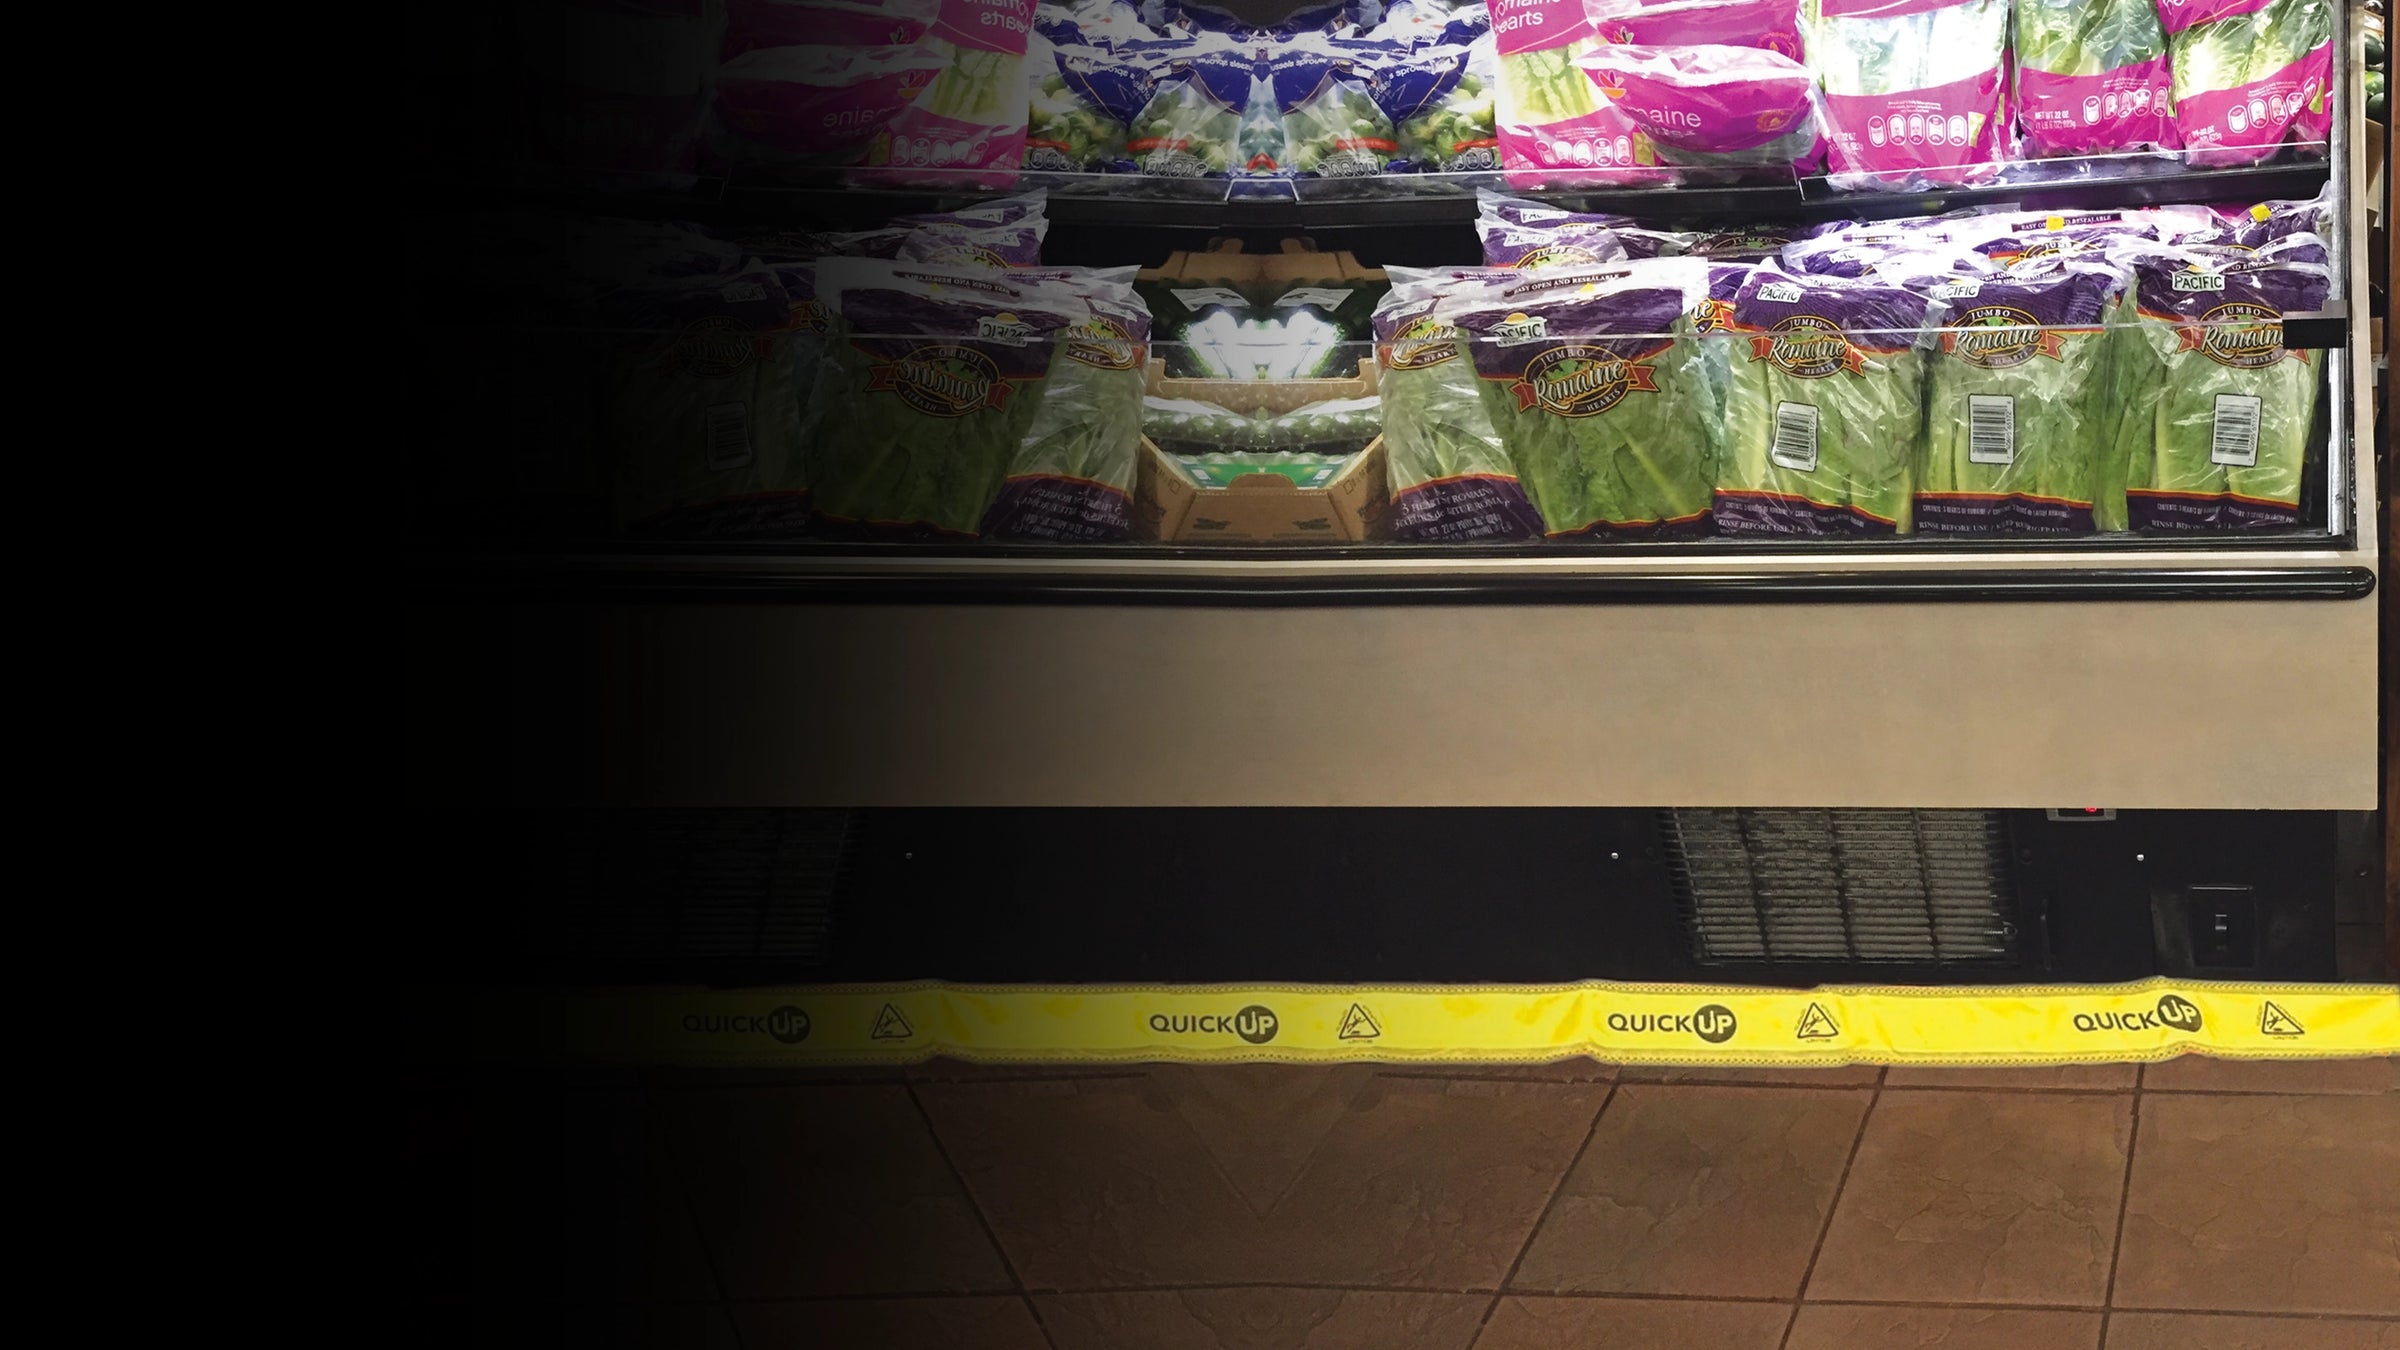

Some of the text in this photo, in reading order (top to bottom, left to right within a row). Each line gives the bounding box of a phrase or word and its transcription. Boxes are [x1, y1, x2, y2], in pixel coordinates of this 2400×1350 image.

[2174, 276, 2222, 288] PACIFIC
[1760, 286, 1799, 301] PACIFIC
[1971, 309, 2010, 320] JUMBO
[2221, 306, 2261, 317] JUMBO
[1789, 319, 1823, 330] JUMBO
[1953, 322, 2041, 359] Romaine
[2201, 324, 2284, 358] Romain
[1541, 348, 1586, 368] JUMBO
[1769, 335, 1846, 368] Romaine
[1533, 361, 1623, 409] Romaine
[1586, 388, 1620, 411] HEARTS
[1608, 1013, 1692, 1033] QUICK
[2073, 1010, 2160, 1032] QUICK
